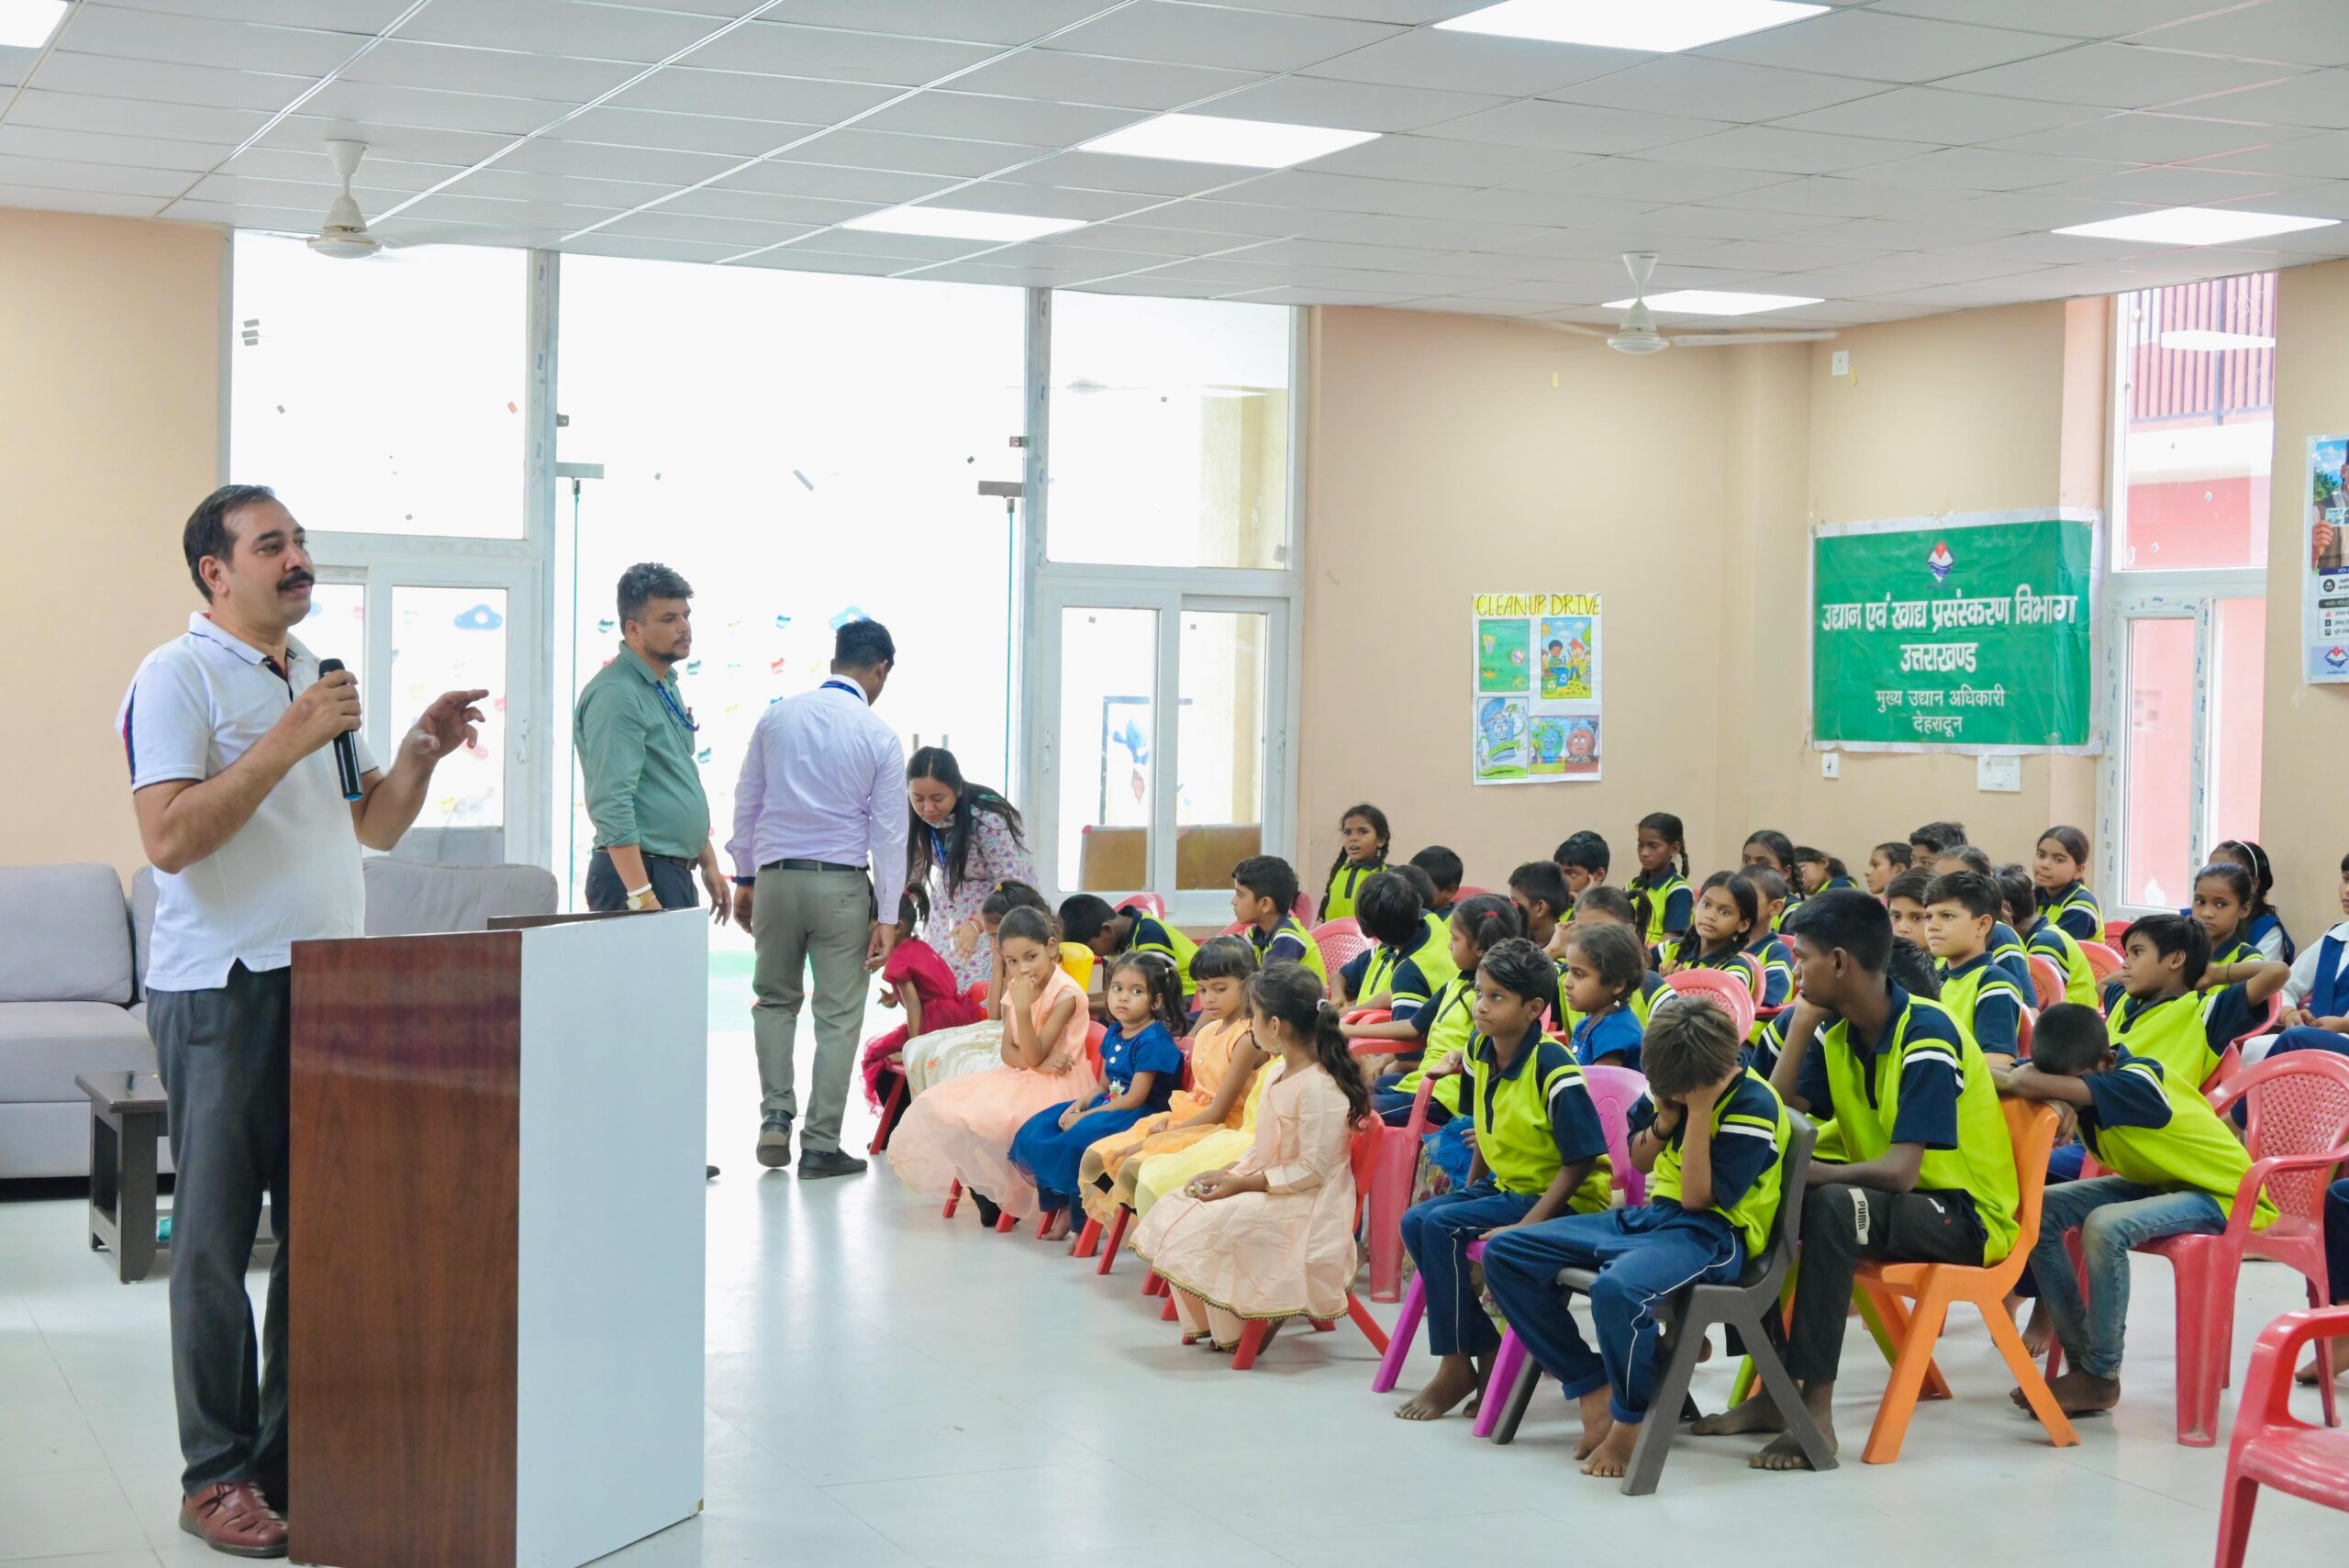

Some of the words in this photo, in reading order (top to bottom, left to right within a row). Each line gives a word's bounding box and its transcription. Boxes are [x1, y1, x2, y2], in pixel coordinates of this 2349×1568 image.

[1549, 594, 1601, 616] DRIVE
[1821, 603, 1863, 631] उद्यान
[1865, 592, 1891, 631] एवं
[1891, 601, 1929, 630] खाद्य
[1932, 588, 2011, 633] प्रसंस्करण
[2015, 584, 2077, 625] विभाग
[1900, 643, 1978, 673] उत्तराखण्ड
[1875, 691, 1904, 714] मुख्य
[1907, 690, 1943, 706] उद्यान
[1949, 684, 2006, 706] अधिकारी
[1911, 710, 1964, 738] देहरादून
